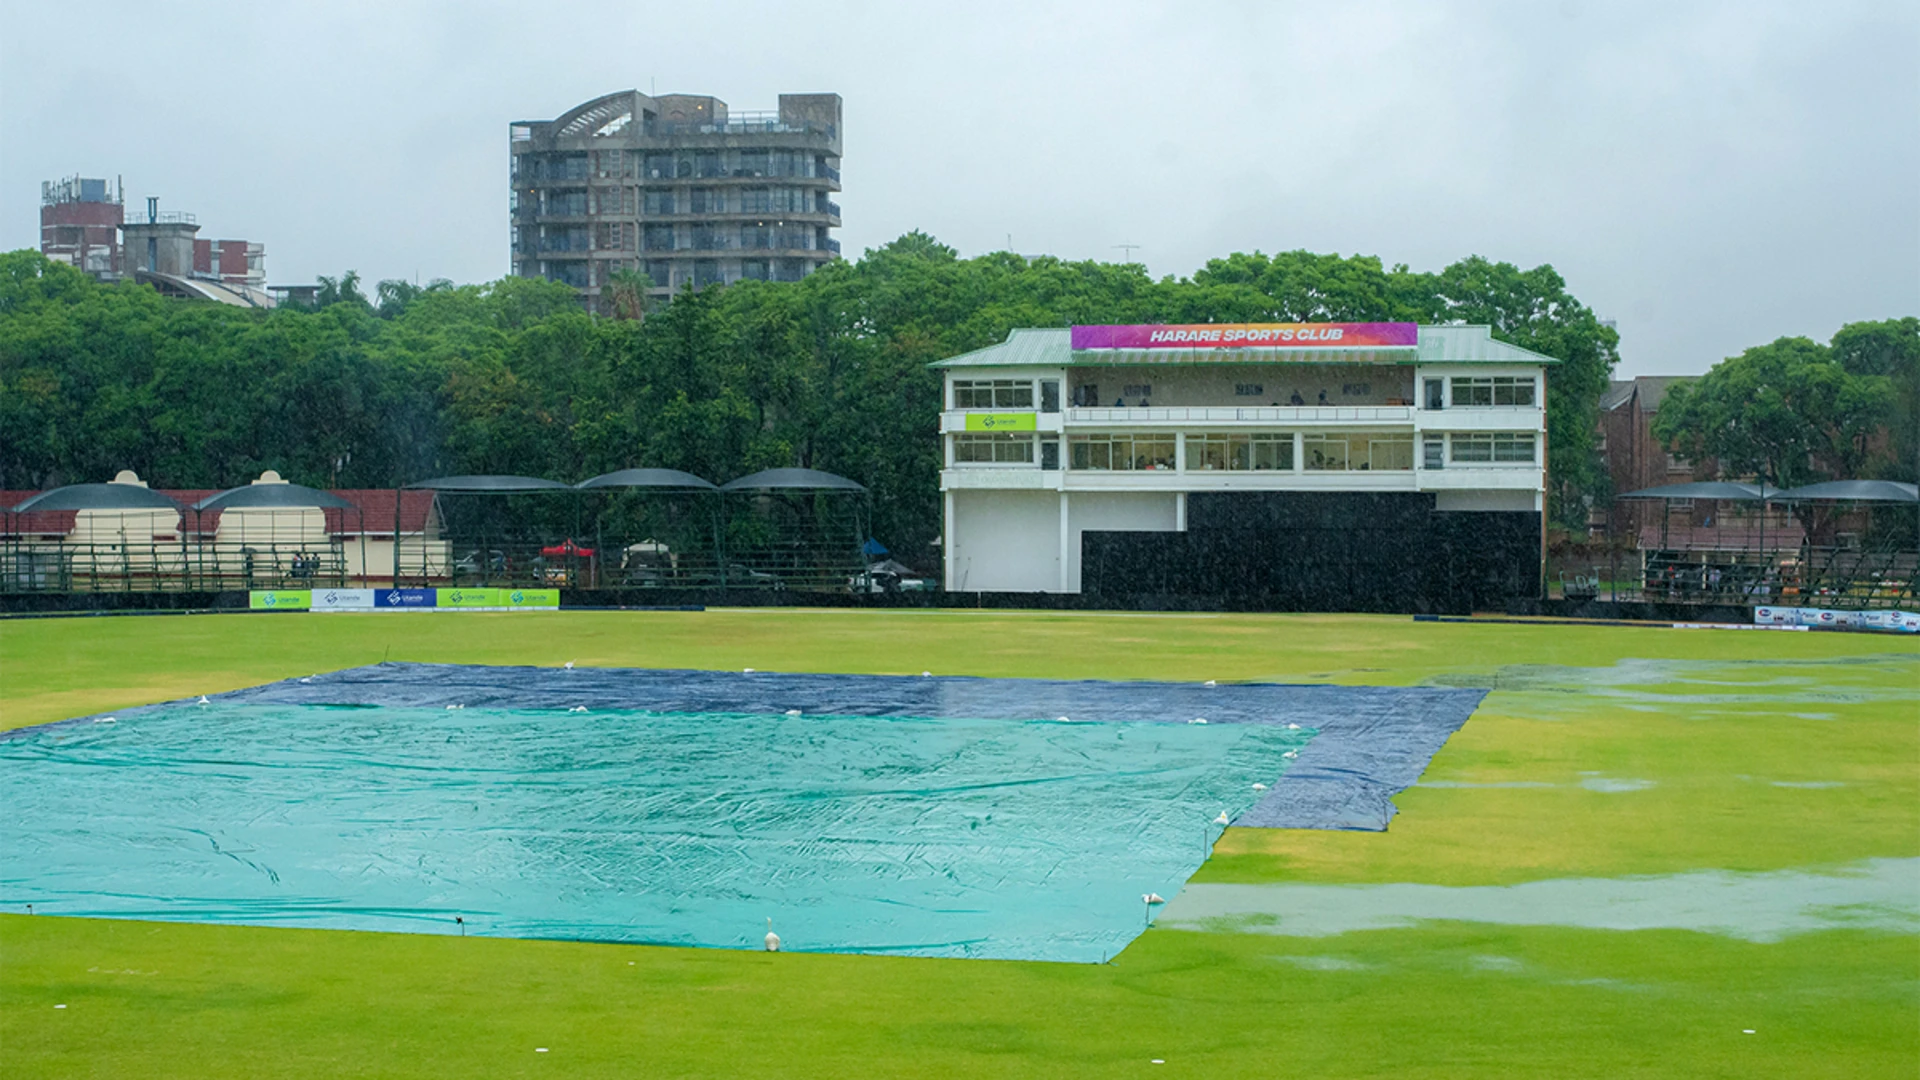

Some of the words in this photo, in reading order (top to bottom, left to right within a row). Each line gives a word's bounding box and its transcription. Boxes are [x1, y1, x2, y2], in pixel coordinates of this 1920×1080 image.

[1150, 331, 1221, 342] HARARE
[1224, 330, 1294, 342] SPORTS
[1297, 329, 1344, 341] CLUB
